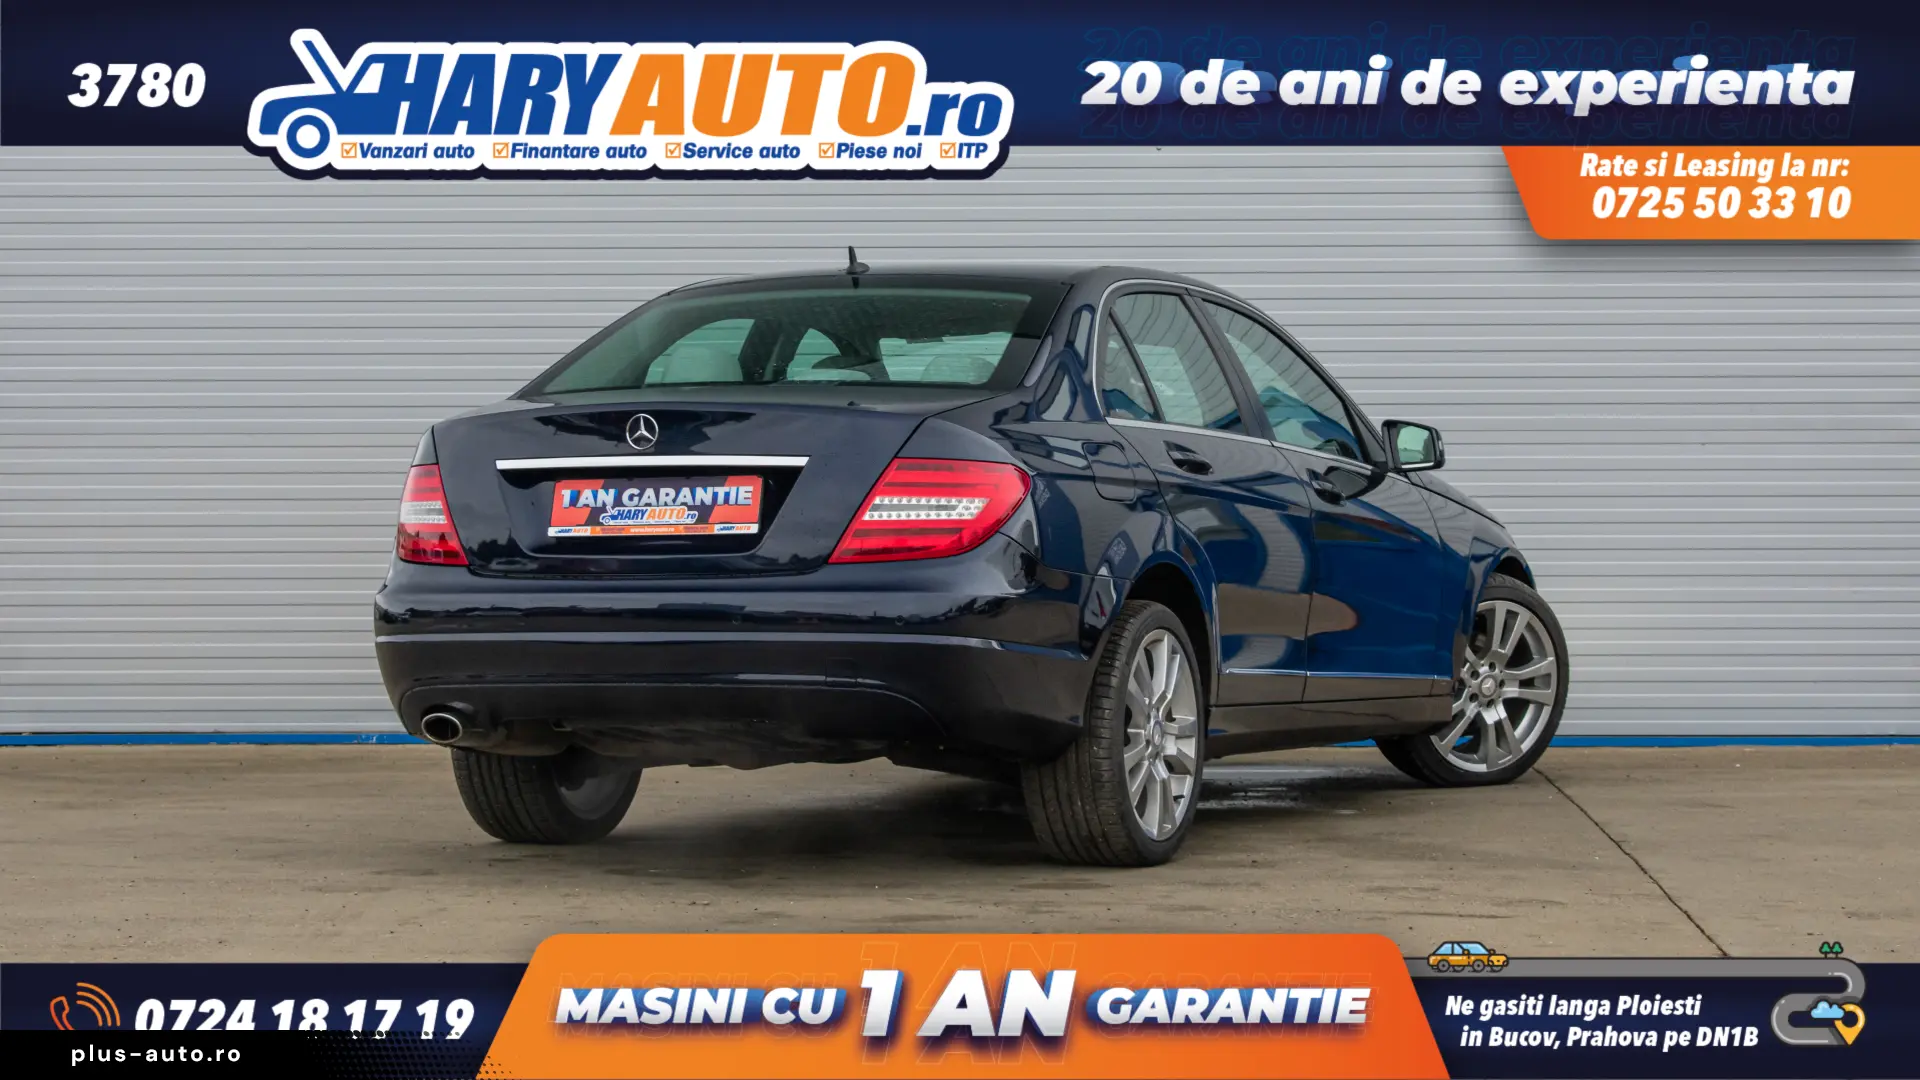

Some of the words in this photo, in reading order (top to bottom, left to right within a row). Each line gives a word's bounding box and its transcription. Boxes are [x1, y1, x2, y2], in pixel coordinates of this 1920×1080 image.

[561, 489, 573, 508] 1
[575, 488, 617, 508] AN
[621, 486, 754, 507] GARANTIE
[615, 508, 697, 521] HARYAUTO.ro
